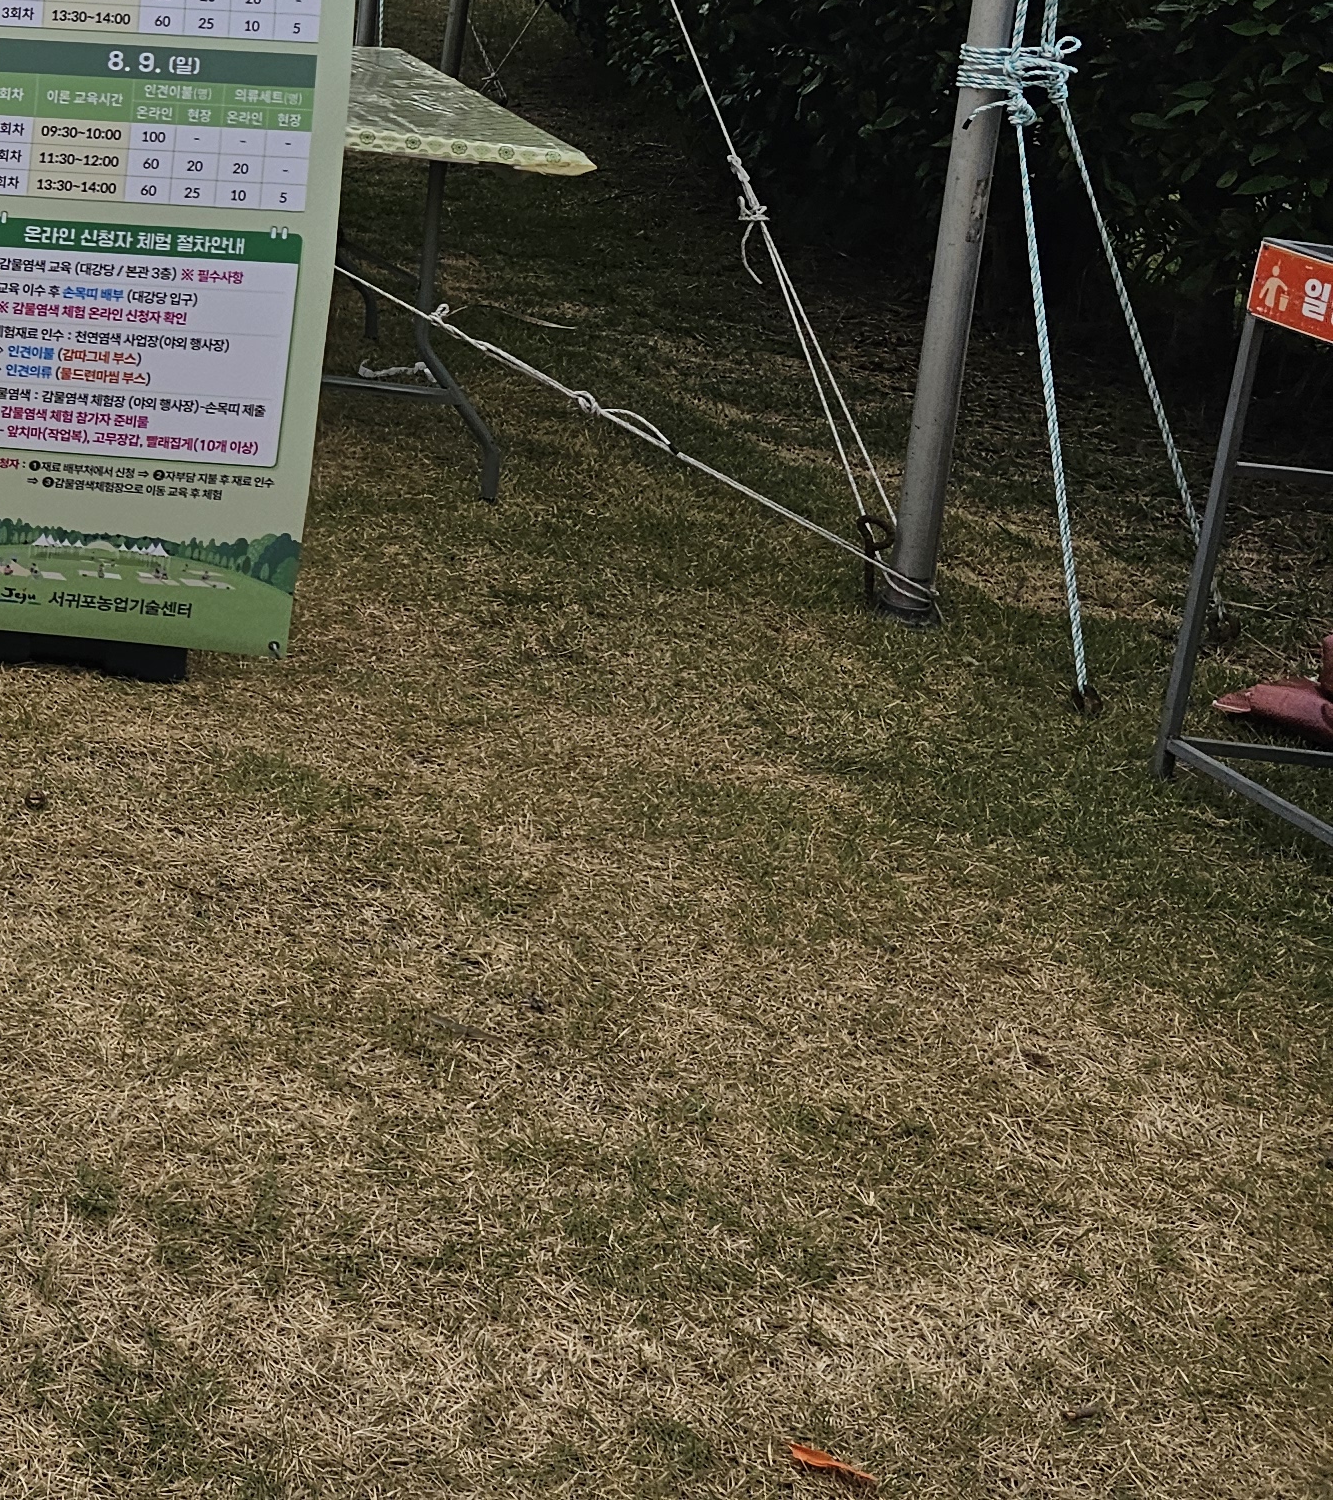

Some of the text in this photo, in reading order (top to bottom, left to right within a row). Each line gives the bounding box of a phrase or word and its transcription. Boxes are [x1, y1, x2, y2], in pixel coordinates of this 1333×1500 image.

[24, 225, 245, 254] 온라인 신청자 체험 절차안내
[1302, 278, 1333, 325] 일
[49, 591, 193, 618] 서귀포농업기술센터
